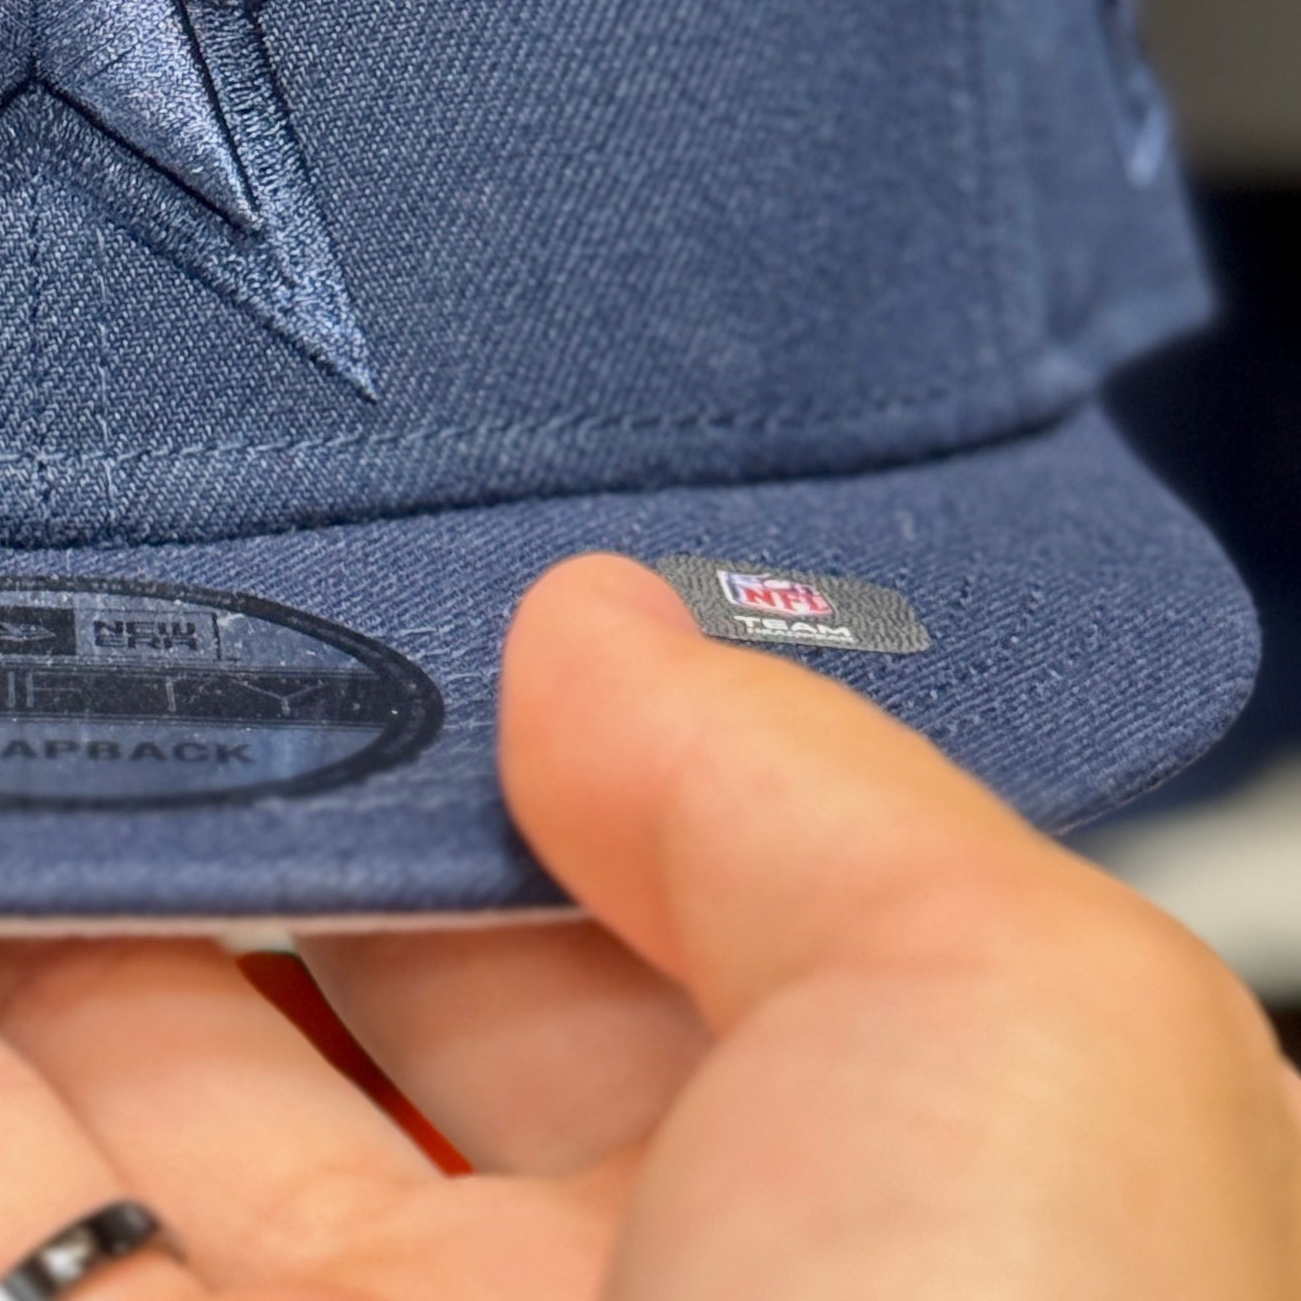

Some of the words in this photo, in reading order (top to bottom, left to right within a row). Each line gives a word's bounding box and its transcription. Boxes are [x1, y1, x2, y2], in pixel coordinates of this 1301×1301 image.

[743, 585, 832, 612] NFL
[93, 619, 196, 636] NEW
[733, 615, 852, 637] TEAM
